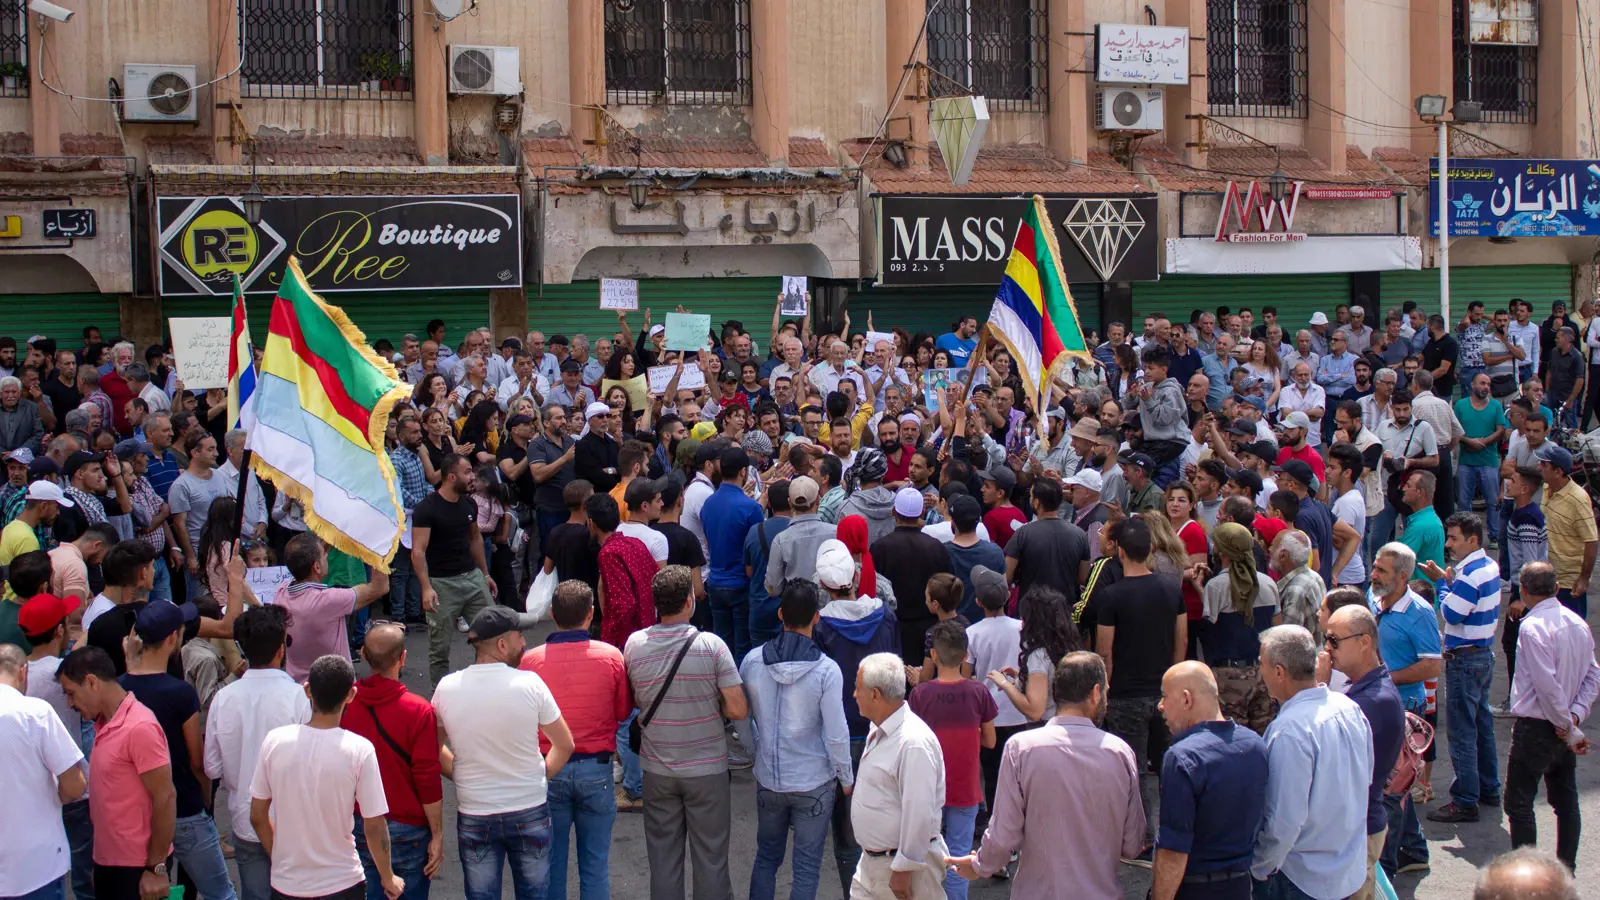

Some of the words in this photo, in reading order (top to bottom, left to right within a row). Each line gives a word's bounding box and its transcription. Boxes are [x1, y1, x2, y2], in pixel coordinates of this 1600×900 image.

[1527, 163, 1556, 177] وكالة
[1456, 209, 1479, 218] IATA
[378, 223, 501, 250] Boutique
[1233, 234, 1267, 242] Fashion
[1269, 233, 1284, 242] For
[1286, 233, 1304, 242] Men
[193, 227, 249, 266] RE
[268, 210, 411, 286] Ree
[607, 299, 634, 309] 2254
